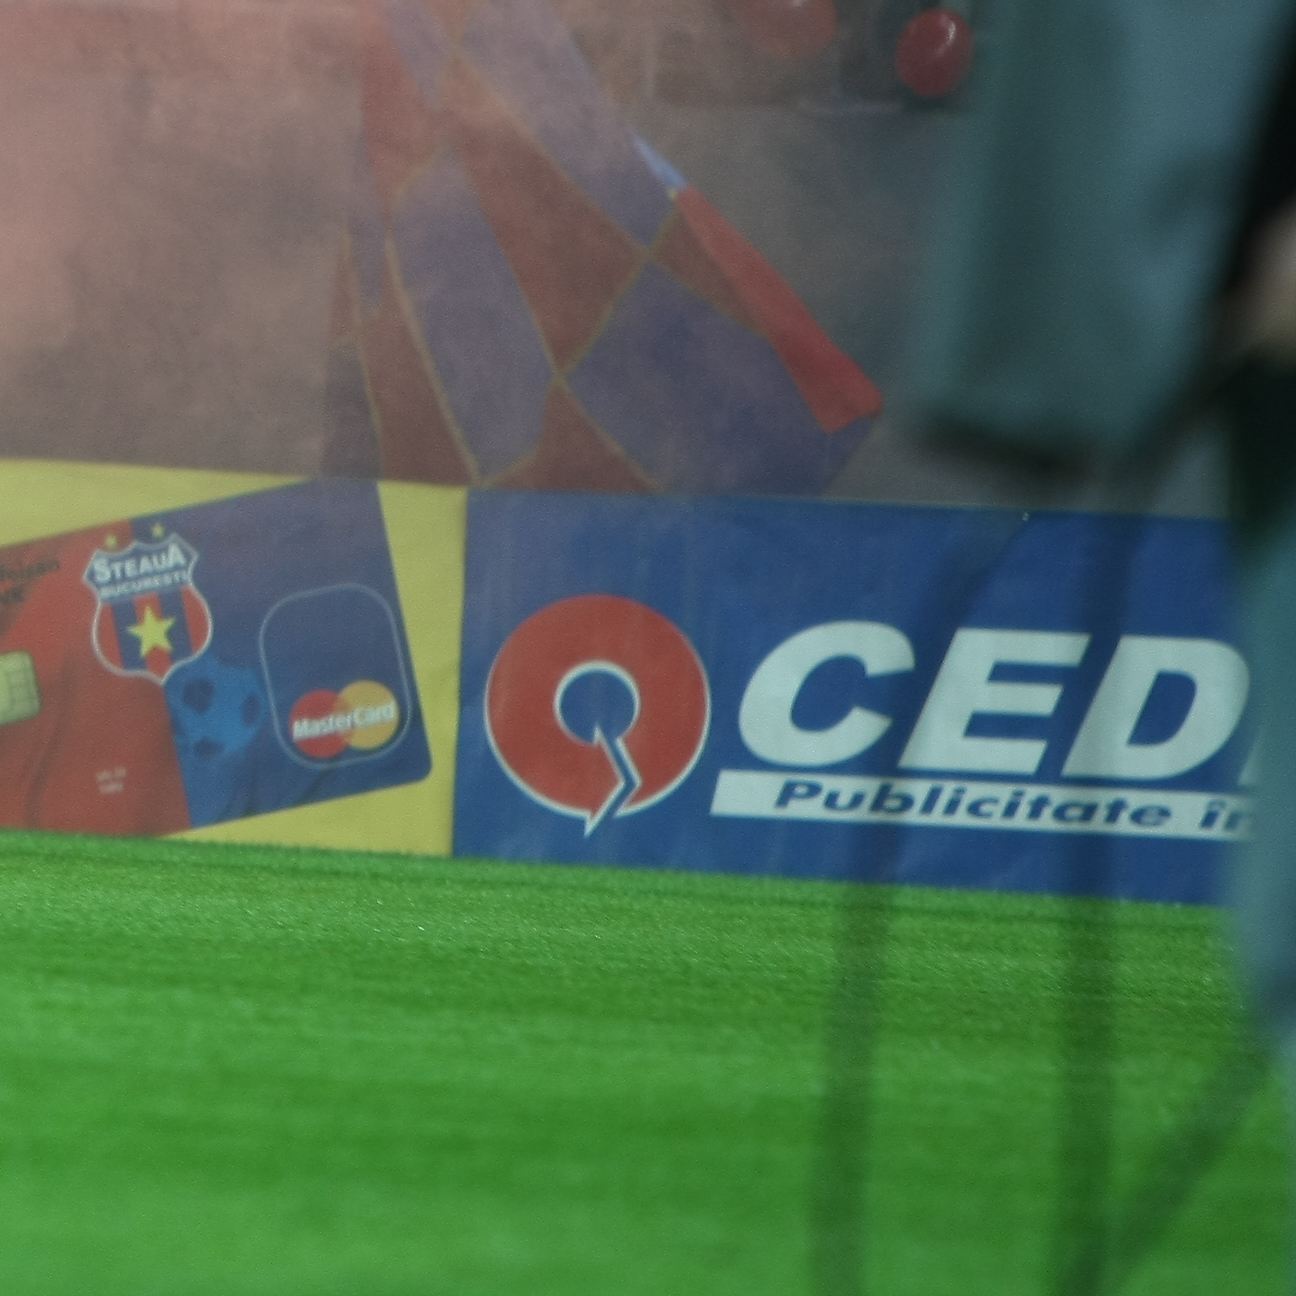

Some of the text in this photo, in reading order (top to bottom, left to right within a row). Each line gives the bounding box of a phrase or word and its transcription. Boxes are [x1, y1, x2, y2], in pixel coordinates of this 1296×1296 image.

[92, 543, 187, 583] STEAUA
[293, 701, 396, 742] MasterCard
[738, 619, 1264, 788] CED
[774, 778, 1173, 829] Publicitate
